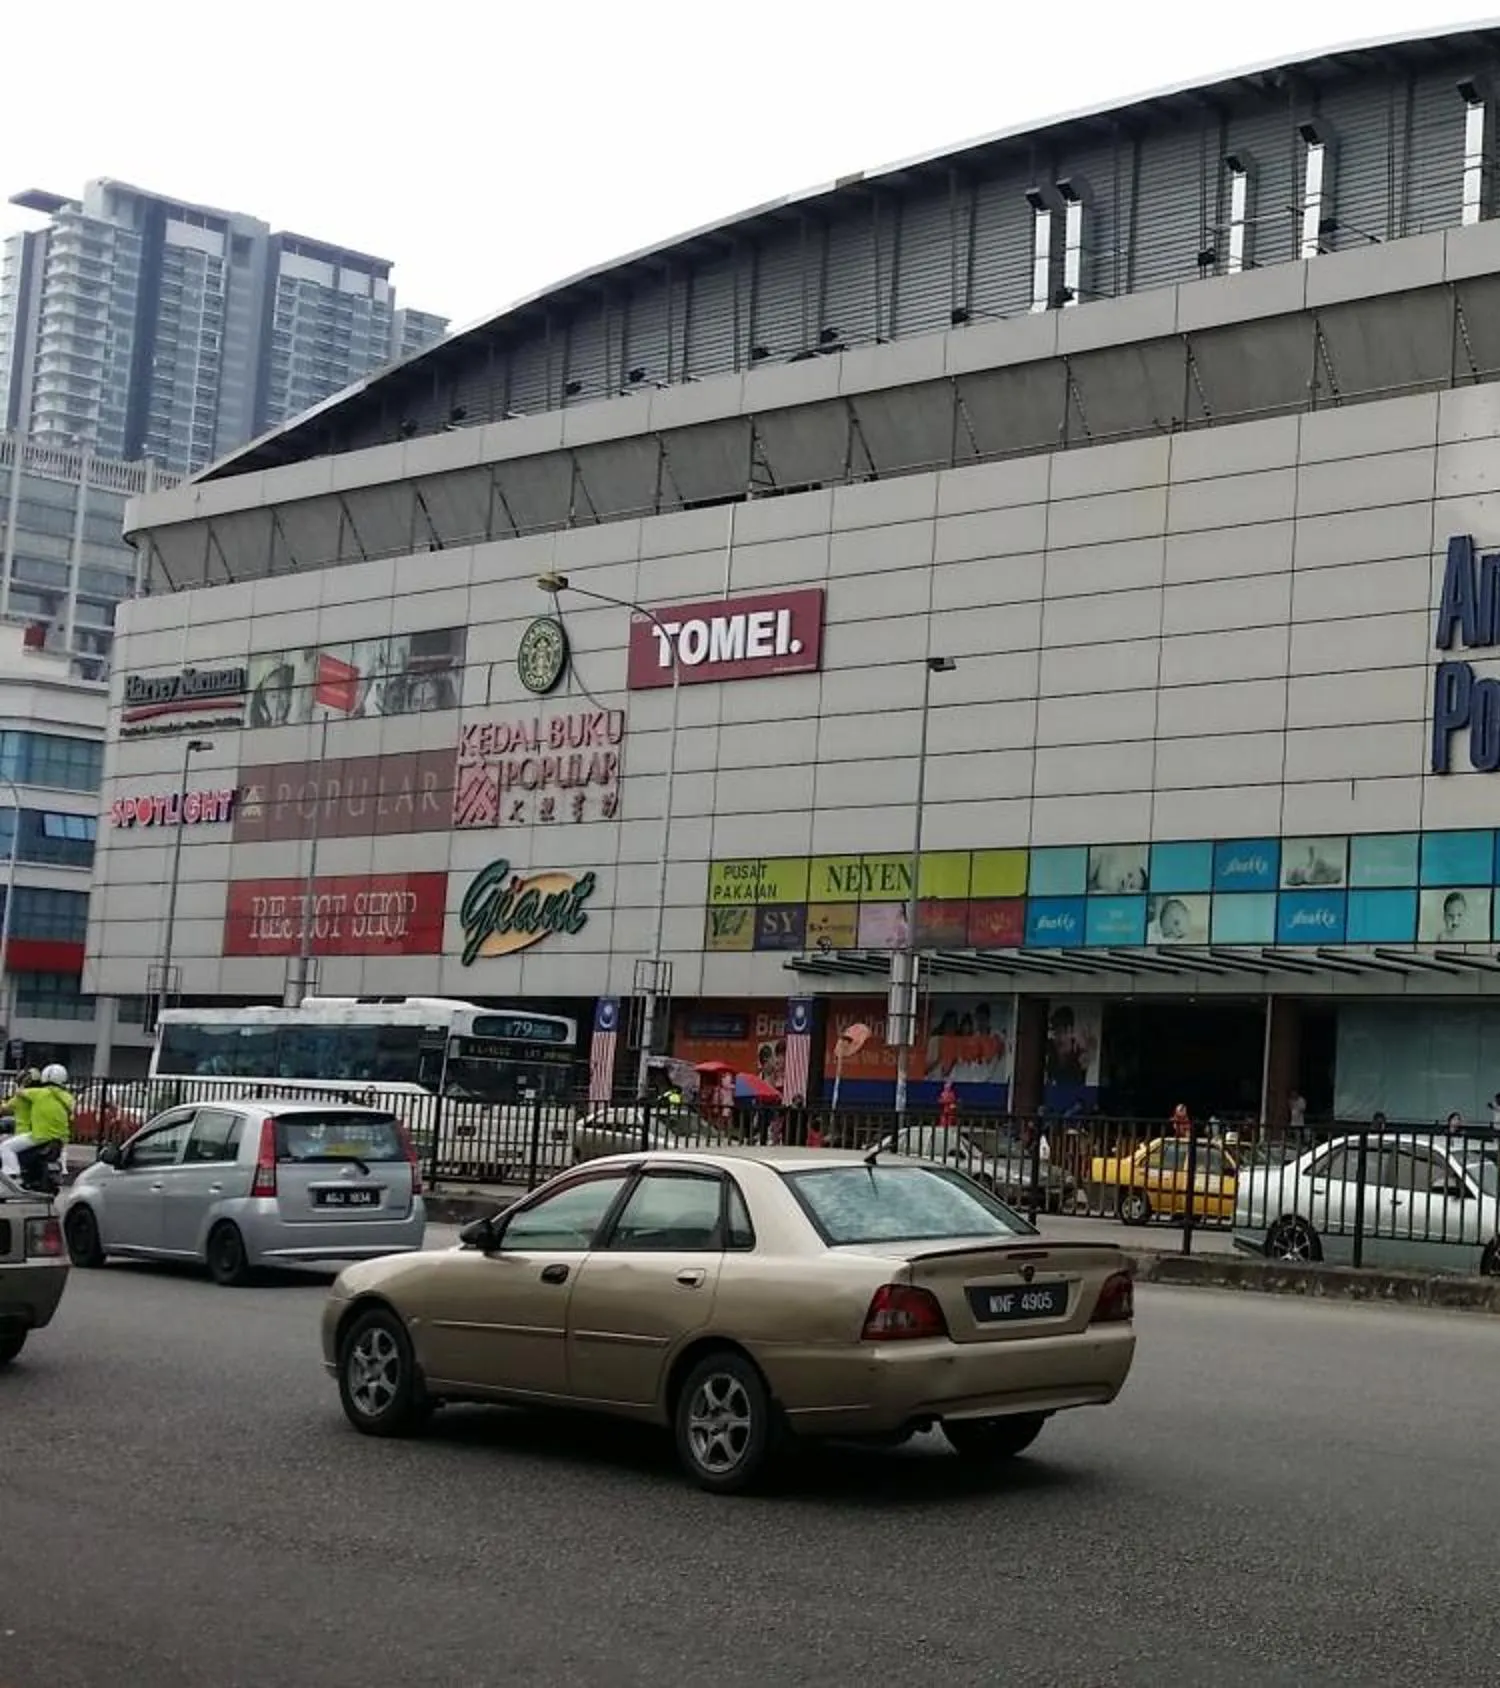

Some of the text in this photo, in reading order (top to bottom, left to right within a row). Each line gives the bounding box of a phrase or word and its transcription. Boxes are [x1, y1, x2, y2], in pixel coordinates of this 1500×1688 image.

[124, 667, 245, 703] Harvey Norman
[460, 709, 625, 757] KEDAI BUKU
[501, 752, 617, 792] POPULAR
[111, 788, 236, 828] SPOTLIGHT
[275, 770, 441, 822] POPULAR
[713, 883, 777, 900] PAKAIAN
[723, 864, 768, 881] PUSAT
[352, 891, 417, 939] SHOP
[460, 858, 596, 967] Giant
[763, 910, 797, 935] SY
[1021, 1291, 1053, 1312] 4905
